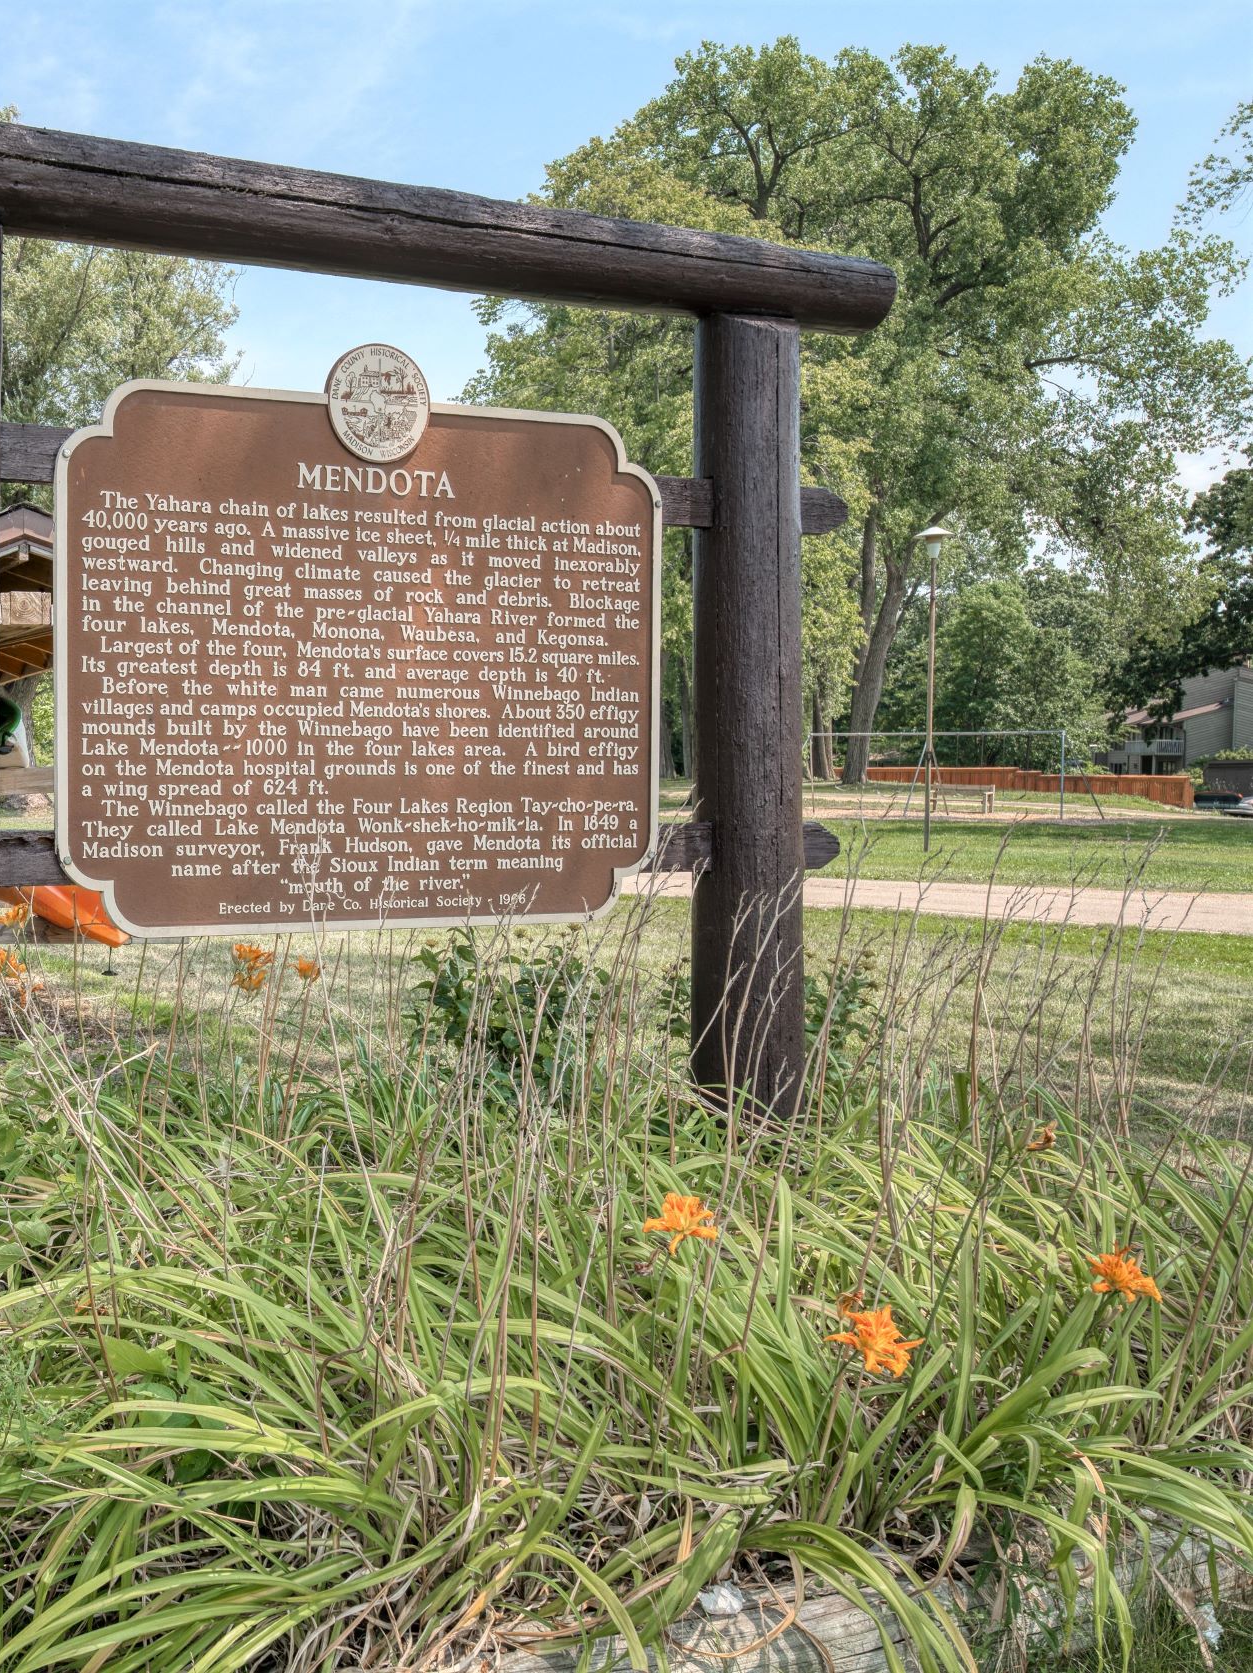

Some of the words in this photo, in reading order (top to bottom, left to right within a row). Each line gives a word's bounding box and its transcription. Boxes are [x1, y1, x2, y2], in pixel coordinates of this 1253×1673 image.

[332, 375, 342, 400] DANE
[340, 350, 366, 374] COUNTY
[370, 347, 410, 370] HISTORICAL
[411, 372, 427, 407] SOCIETY
[342, 430, 374, 457] MADISON
[296, 461, 456, 500] MENDOTA
[100, 490, 139, 510] The
[145, 493, 212, 514] Yahara
[219, 498, 270, 518] chain
[276, 502, 297, 519] of
[302, 502, 349, 522] lakes
[354, 508, 428, 526] resulted
[434, 510, 477, 529] from
[482, 514, 537, 533] glacial
[541, 519, 591, 535] action
[595, 520, 641, 538] about
[81, 509, 148, 531] 40,000
[153, 518, 208, 534] years
[214, 522, 252, 539] ago.
[261, 520, 276, 538] A
[282, 525, 350, 541] massive
[355, 526, 381, 543] ice
[386, 527, 437, 548] sheet,
[465, 532, 501, 549] mile
[505, 534, 548, 552] thick
[552, 537, 569, 553] at
[572, 536, 642, 558] Madison,
[81, 534, 151, 554] gouged
[165, 535, 206, 554] hills
[220, 539, 255, 557] and
[270, 542, 343, 561] widened
[357, 546, 418, 567] valleys
[430, 553, 448, 565] as
[461, 551, 475, 567] it
[488, 554, 542, 570] moved
[554, 556, 641, 577] inexorably
[81, 554, 179, 574] westward.
[199, 557, 284, 582] Changing
[295, 562, 361, 581] climate
[373, 568, 432, 584] caused
[443, 569, 472, 586] the
[484, 571, 542, 591] glacier
[553, 574, 572, 590] to
[582, 576, 641, 593] retreat
[82, 595, 102, 612] in
[113, 595, 145, 613] the
[156, 597, 232, 616] channel
[242, 600, 265, 617] of
[274, 601, 304, 619] the
[423, 606, 482, 625] Yahara
[490, 608, 538, 626] River
[546, 611, 606, 629] formed
[614, 613, 640, 630] the
[81, 614, 127, 633] four
[140, 616, 195, 636] lakes,
[212, 617, 296, 639] Mendota,
[312, 619, 385, 641] Monona,
[400, 624, 480, 644] Waubesa,
[495, 628, 526, 645] and
[537, 629, 609, 650] Kegonsa.
[100, 636, 173, 659] Largest
[178, 639, 201, 655] of
[206, 639, 237, 656] the
[242, 639, 287, 659] four,
[296, 640, 382, 660] Mendota's
[387, 644, 448, 662] surface
[453, 650, 505, 663] covers
[509, 646, 538, 664] 15.2
[541, 652, 594, 669] square
[597, 650, 640, 666] miles.
[102, 676, 169, 695] Before
[181, 679, 213, 696] the
[226, 679, 278, 697] white
[290, 685, 328, 698] man
[339, 686, 384, 699] came
[396, 686, 481, 700] numerous
[491, 682, 581, 704] Winnebago
[590, 686, 640, 703] Indian
[82, 718, 156, 736] mounds
[166, 718, 213, 736] built
[223, 719, 248, 740] by
[257, 720, 287, 737] the
[297, 717, 393, 742] Winnebago
[402, 721, 440, 738] have
[449, 720, 489, 738] been
[498, 722, 575, 739] identified
[583, 723, 639, 739] around
[82, 763, 106, 776] on
[115, 759, 147, 776] the
[155, 758, 235, 776] Mendota
[243, 759, 316, 780] hospital
[324, 759, 396, 780] grounds
[404, 761, 418, 776] is
[425, 763, 456, 776] one
[463, 759, 482, 776] of
[489, 760, 516, 776] the
[523, 760, 571, 776] finest
[576, 760, 605, 776] and
[613, 760, 639, 776] has
[81, 784, 93, 797] a
[103, 780, 148, 801] wing
[158, 779, 222, 801] spread
[232, 779, 253, 796] of
[263, 777, 298, 796] 624
[308, 779, 329, 796] ft.
[100, 799, 140, 817] The
[147, 799, 248, 820] Winnebago
[256, 798, 308, 816] called
[316, 799, 345, 815] the
[352, 798, 393, 815] Four
[400, 797, 449, 814] Lakes
[456, 797, 514, 818] Region
[81, 820, 134, 841] They
[146, 819, 202, 837] called
[214, 818, 259, 836] Lake
[270, 817, 346, 835] Mendota
[558, 815, 574, 832] In
[583, 813, 619, 831] 1849
[629, 819, 638, 830] a
[82, 840, 164, 859] Madison
[176, 843, 265, 859] surveyor,
[278, 835, 333, 857] Frank
[345, 836, 413, 854] Hudson,
[426, 839, 463, 856] gave
[473, 834, 541, 851] Mendota
[551, 834, 571, 850] its
[581, 832, 638, 849] official
[171, 863, 222, 877] name
[231, 859, 281, 877] after
[291, 858, 319, 874] the
[329, 857, 378, 873] Sioux
[387, 856, 440, 872] Indian
[449, 855, 492, 871] term
[496, 853, 564, 872] meaning
[353, 876, 372, 892] of
[382, 875, 409, 891] the
[219, 902, 271, 915] Erected
[279, 901, 295, 915] by
[343, 898, 363, 911] Co.
[436, 895, 483, 909] Society
